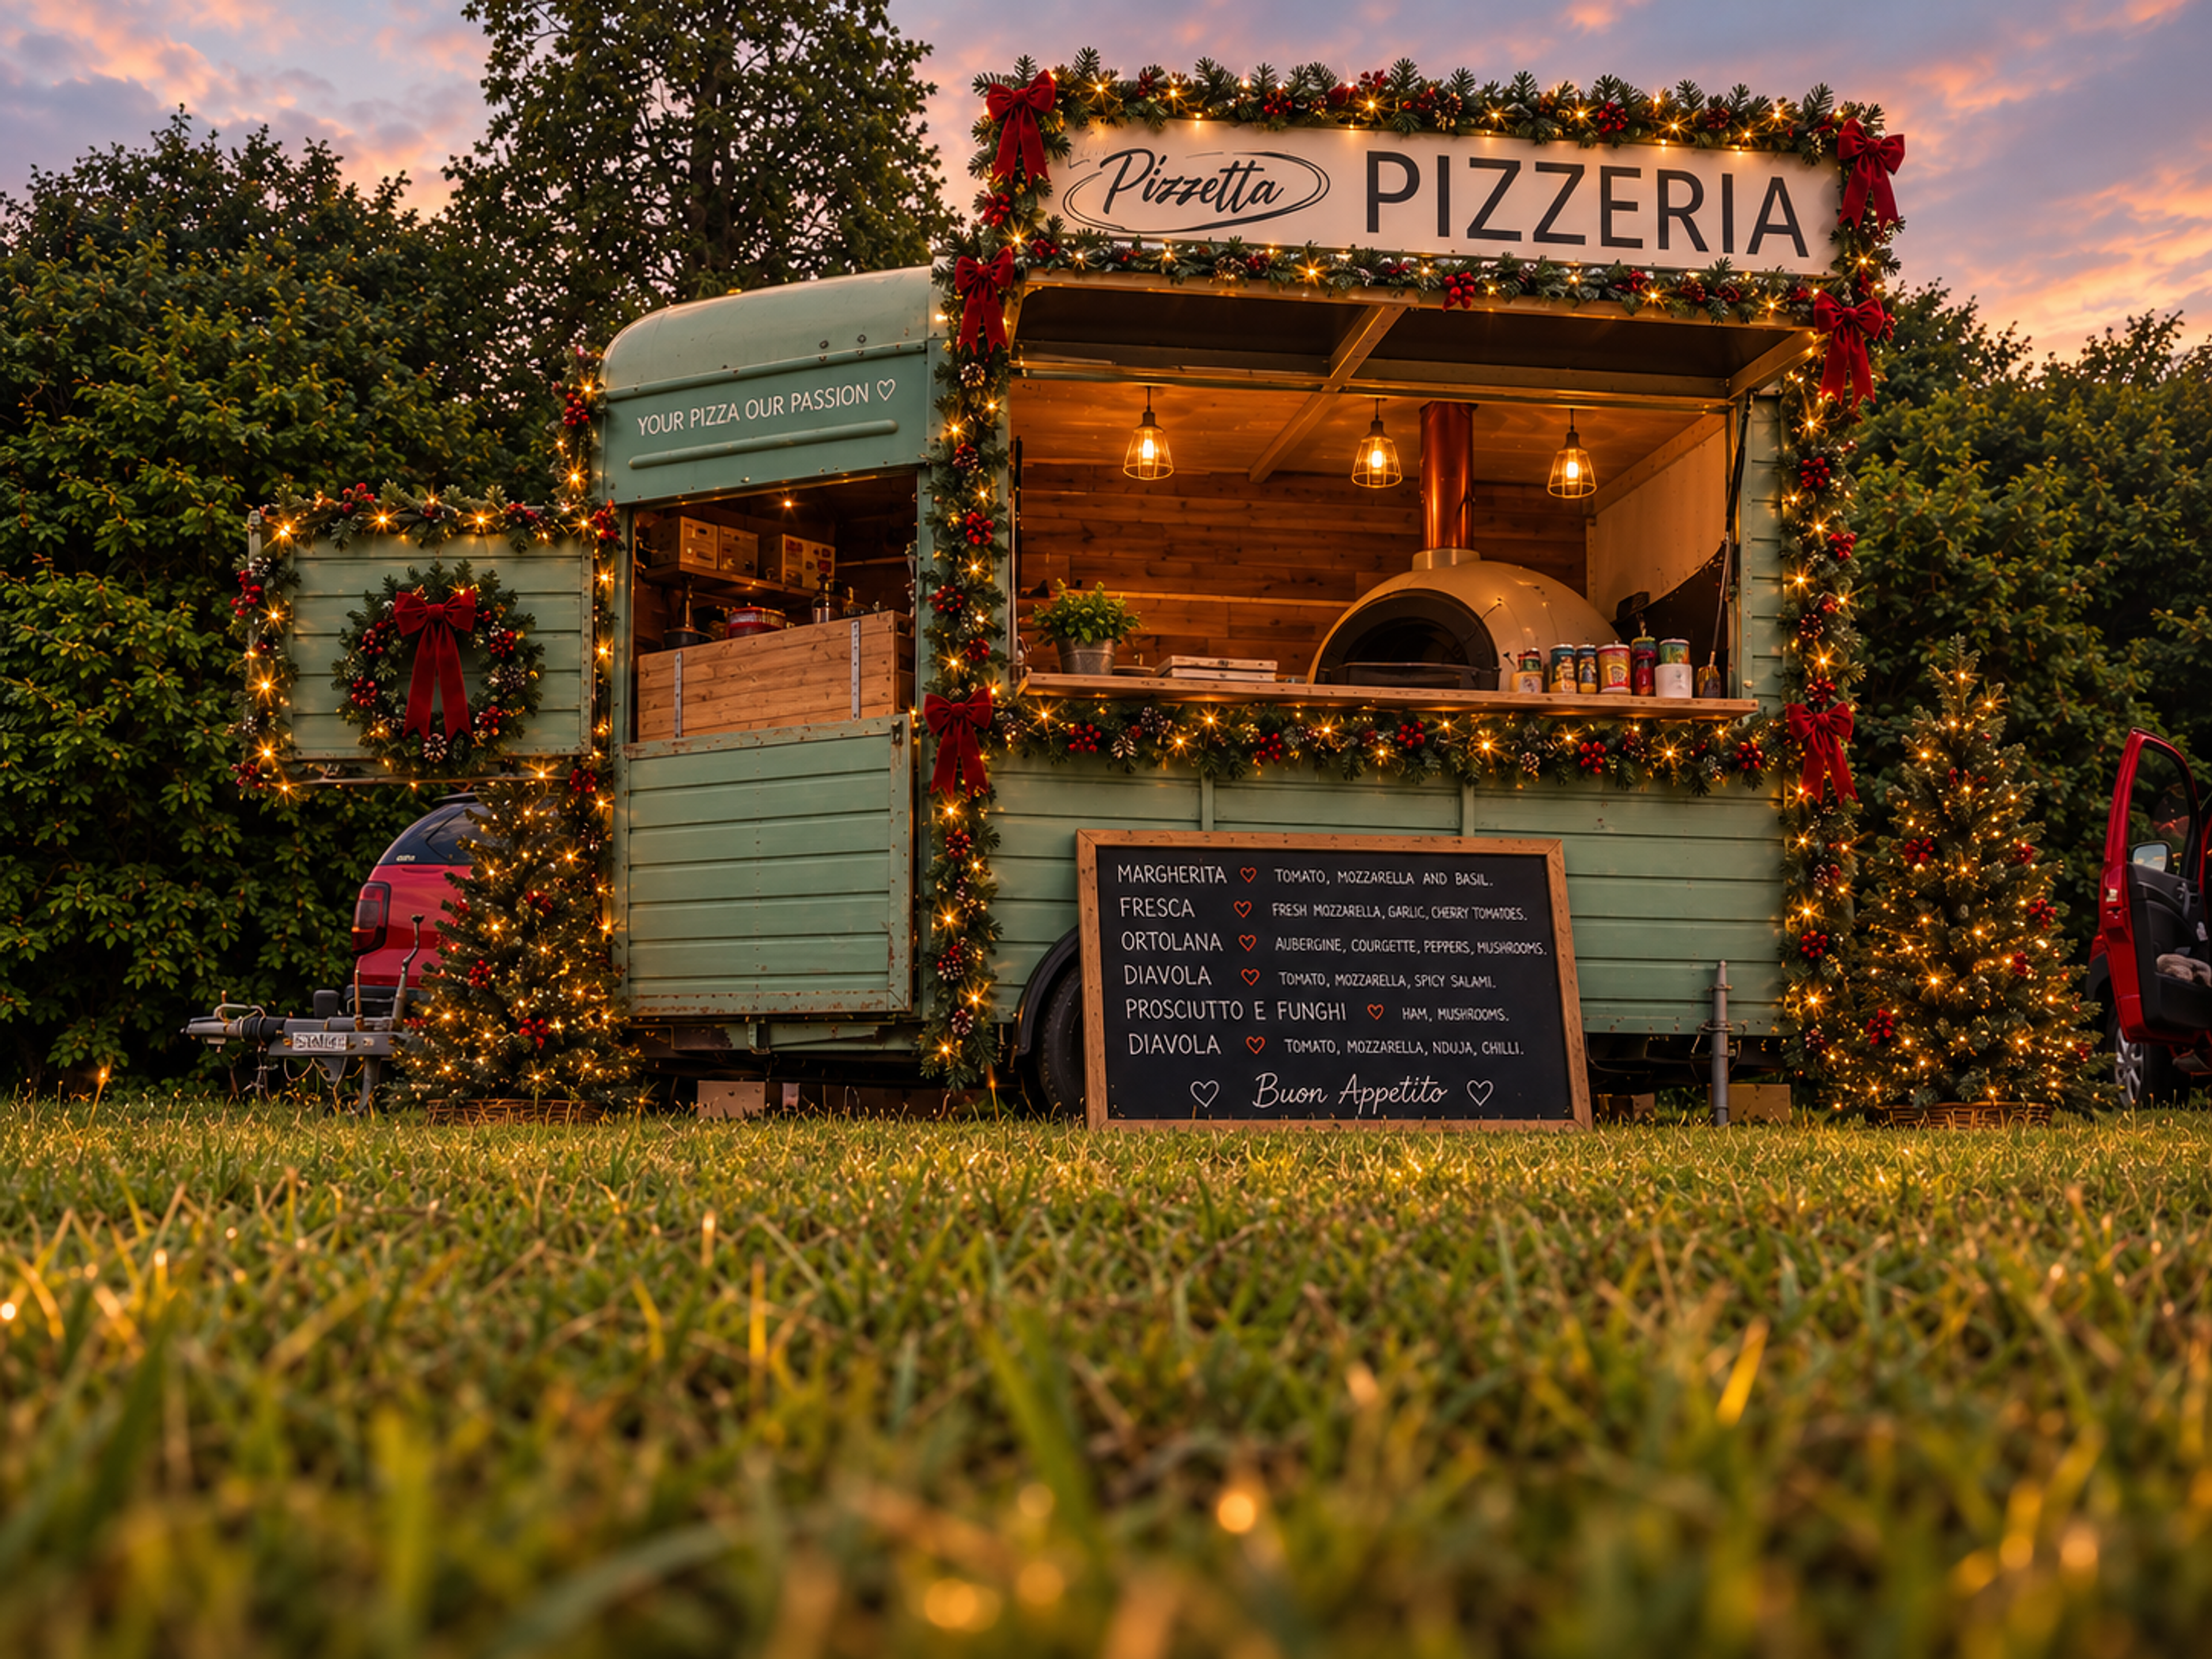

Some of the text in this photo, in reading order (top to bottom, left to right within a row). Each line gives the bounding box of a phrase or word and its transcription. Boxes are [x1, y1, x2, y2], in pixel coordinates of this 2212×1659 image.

[1099, 148, 1285, 215] Pizzetta
[1366, 150, 1810, 258] PIZZERIA
[637, 382, 869, 436] YOUR PIZZA OUR PASSION
[1118, 864, 1494, 887] MARGHERITA TOMATO, MOZZARELLA AND BASIL.
[1119, 896, 1195, 918] FRESCA
[1272, 902, 1308, 917] FRESH
[1313, 904, 1385, 920] MOZZARELLA,
[1388, 905, 1429, 921] GARLIC,
[1431, 906, 1469, 919] CHERRY
[1121, 931, 1547, 956] ORTOLANA AUBERGINE, COURGETTE, PEPPERS, MUSHROOMS.
[1124, 964, 1497, 990] DIAVOLA TOMATO, MOZZARELLA, SPICY SALAMI.
[1126, 998, 1509, 1022] PROSCIUTTO E FUNGHI HAM, MUSHROOMS.
[1128, 1033, 1524, 1056] DIAVOLA TOMATO, MOZZARELLA, NDUJA, CHILLI.
[1252, 1072, 1448, 1115] Buon Appetito
